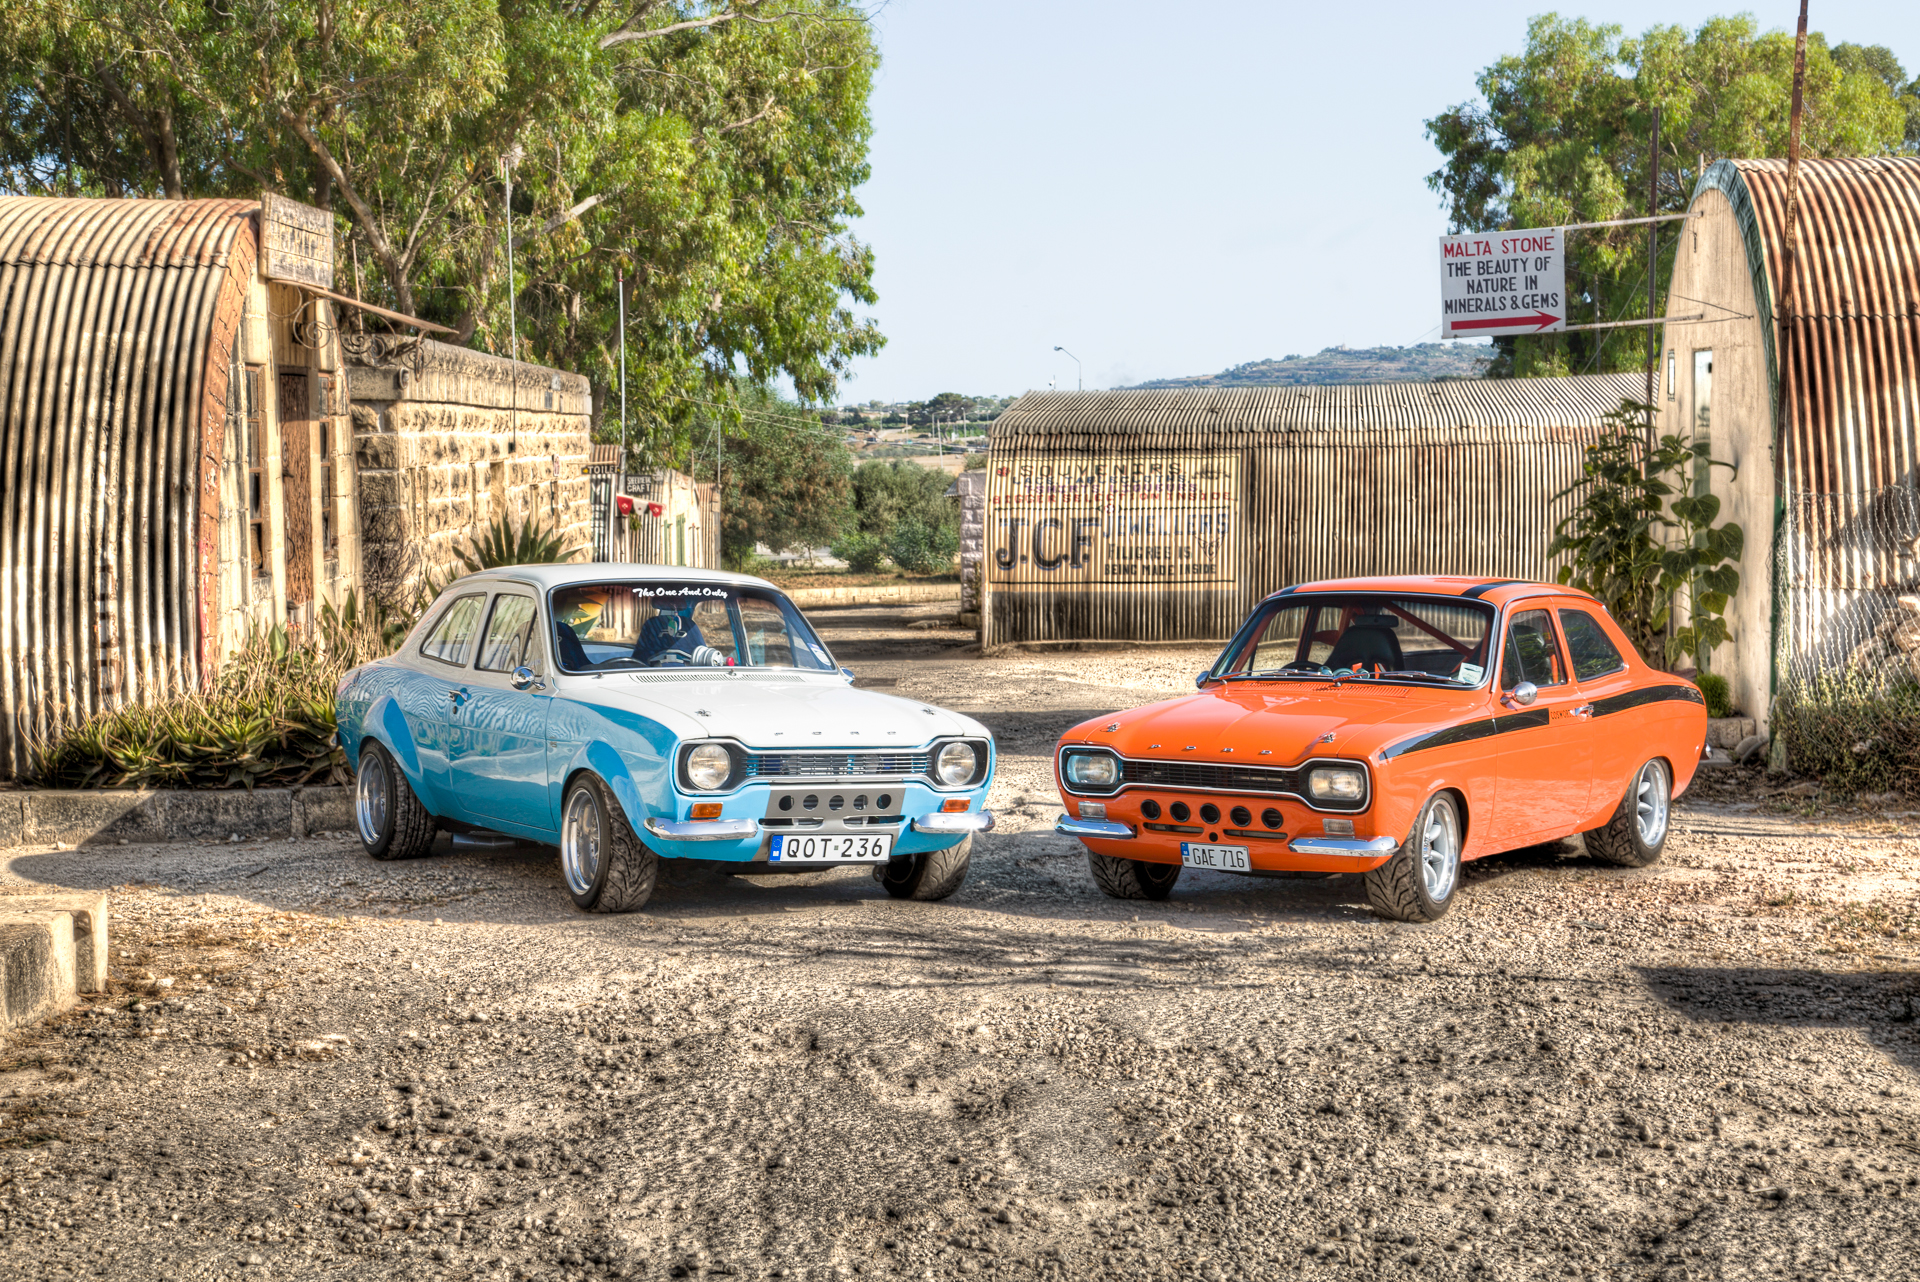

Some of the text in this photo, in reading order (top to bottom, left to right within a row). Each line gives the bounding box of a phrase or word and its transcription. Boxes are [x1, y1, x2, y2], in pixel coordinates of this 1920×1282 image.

[1444, 236, 1555, 258] MALTA STONE
[1447, 256, 1551, 277] THE BEAUTY OF
[1466, 275, 1538, 295] NATURE IN
[1444, 296, 1506, 314] MINERALS
[587, 465, 619, 475] TOILET
[1020, 462, 1182, 478] SOUVENIRS
[1103, 513, 1229, 539] JEWELLERS
[1107, 543, 1192, 560] FILIGREE IS
[1104, 563, 1217, 576] BEING MADE INSIDE
[632, 587, 728, 599] The One And Only
[1192, 848, 1245, 868] GAE 716
